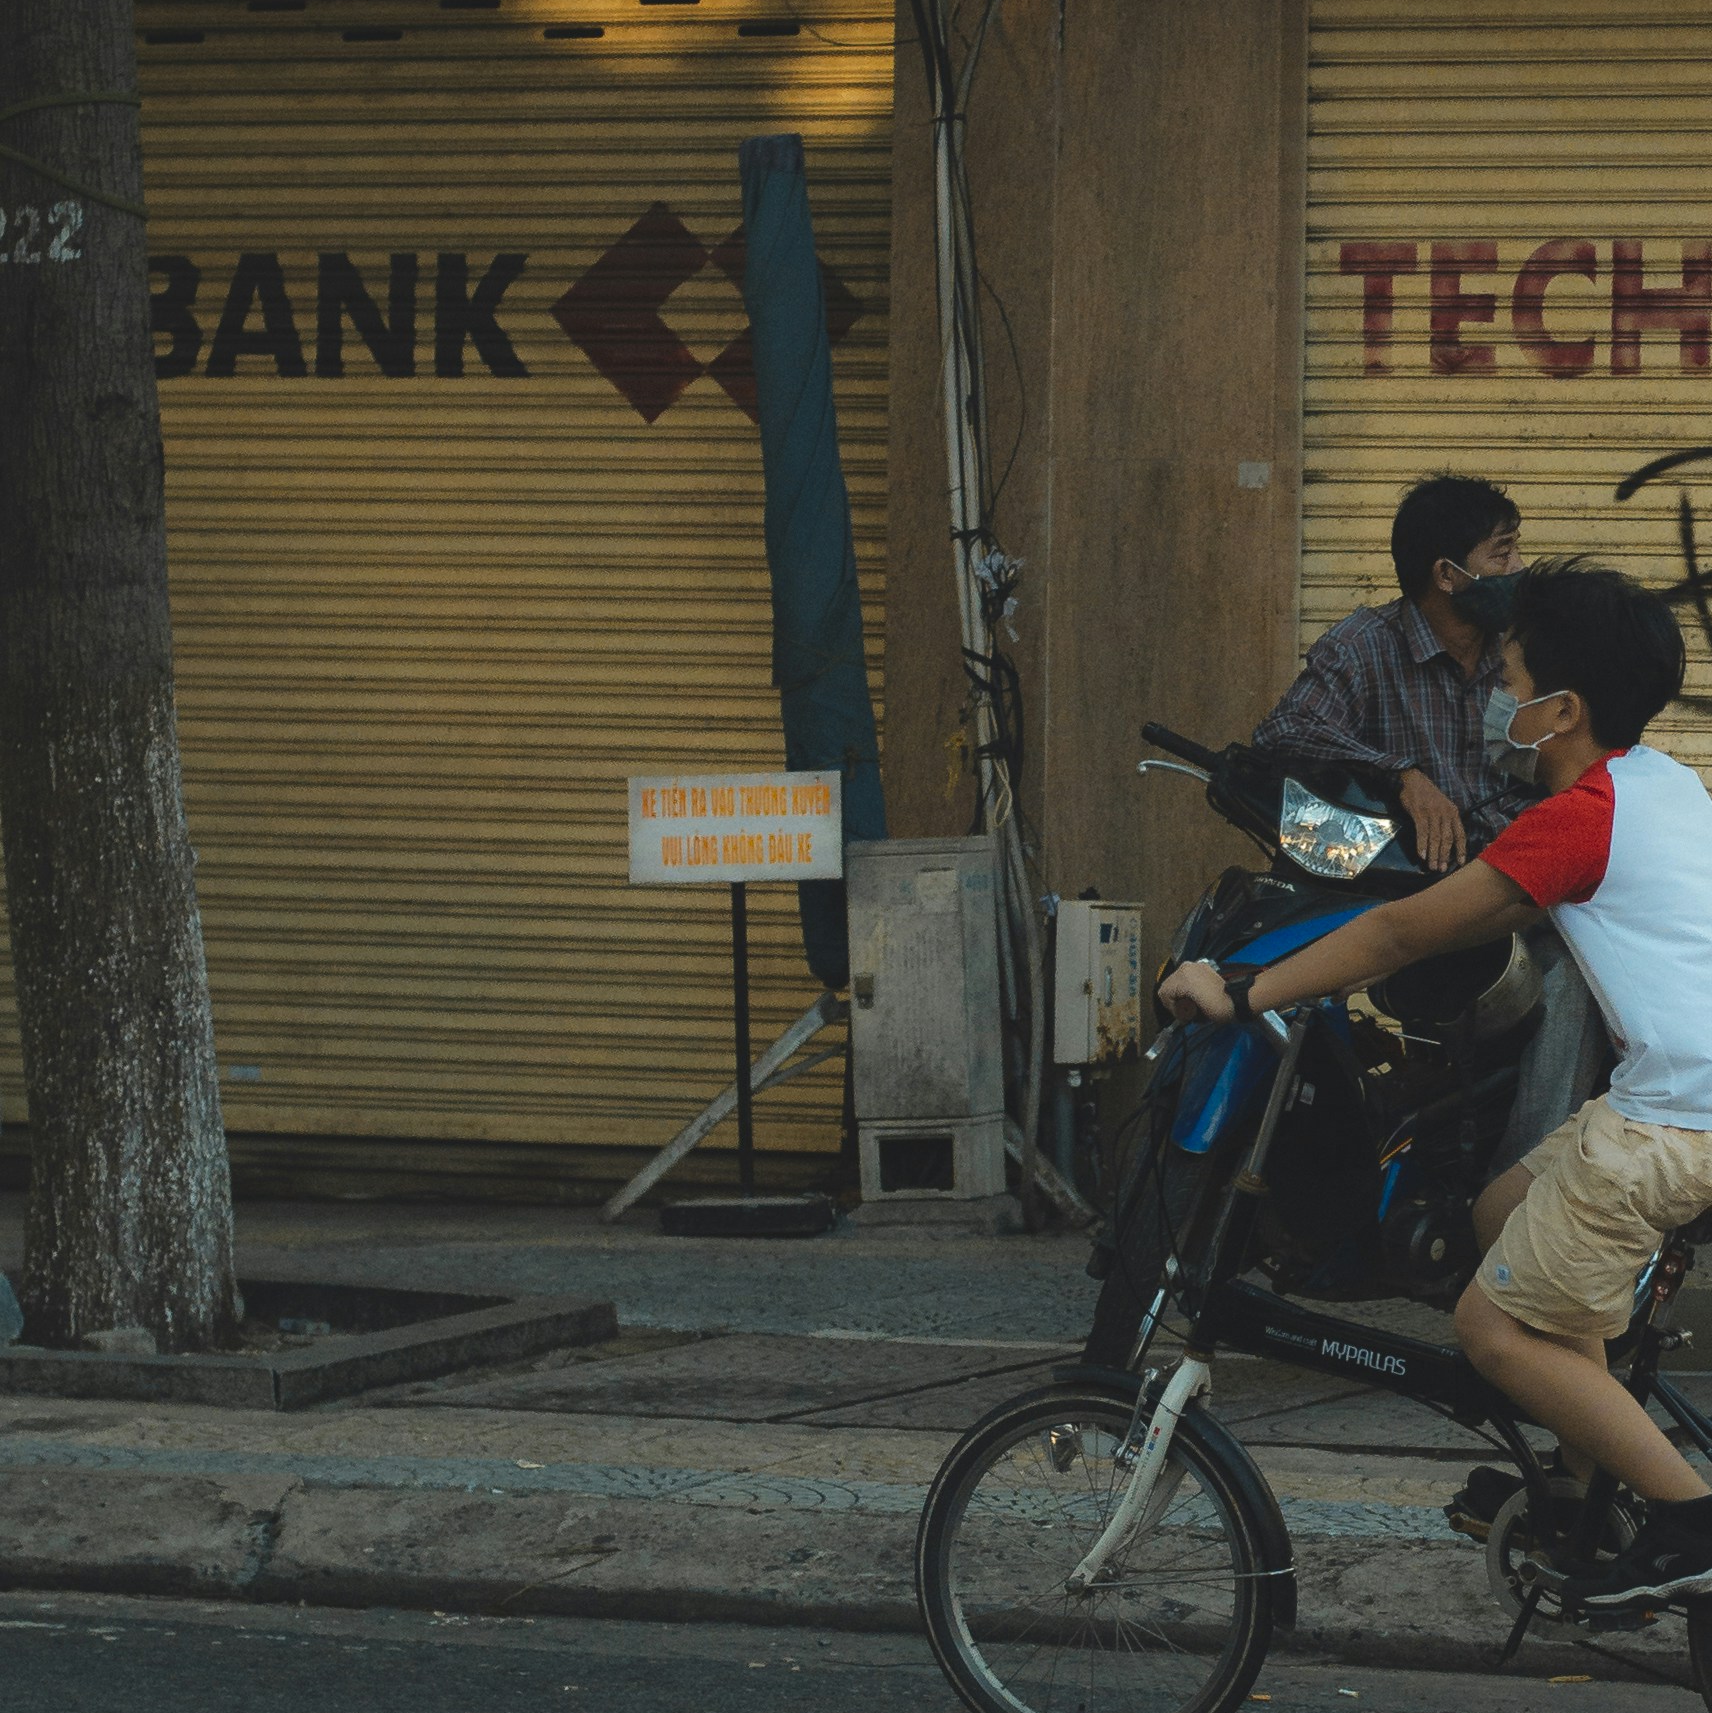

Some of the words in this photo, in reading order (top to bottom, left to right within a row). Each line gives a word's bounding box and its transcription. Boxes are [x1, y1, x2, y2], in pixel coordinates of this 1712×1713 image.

[147, 253, 531, 378] BANK
[690, 787, 707, 817] RA
[1321, 1337, 1407, 1377] MYPALLAS
